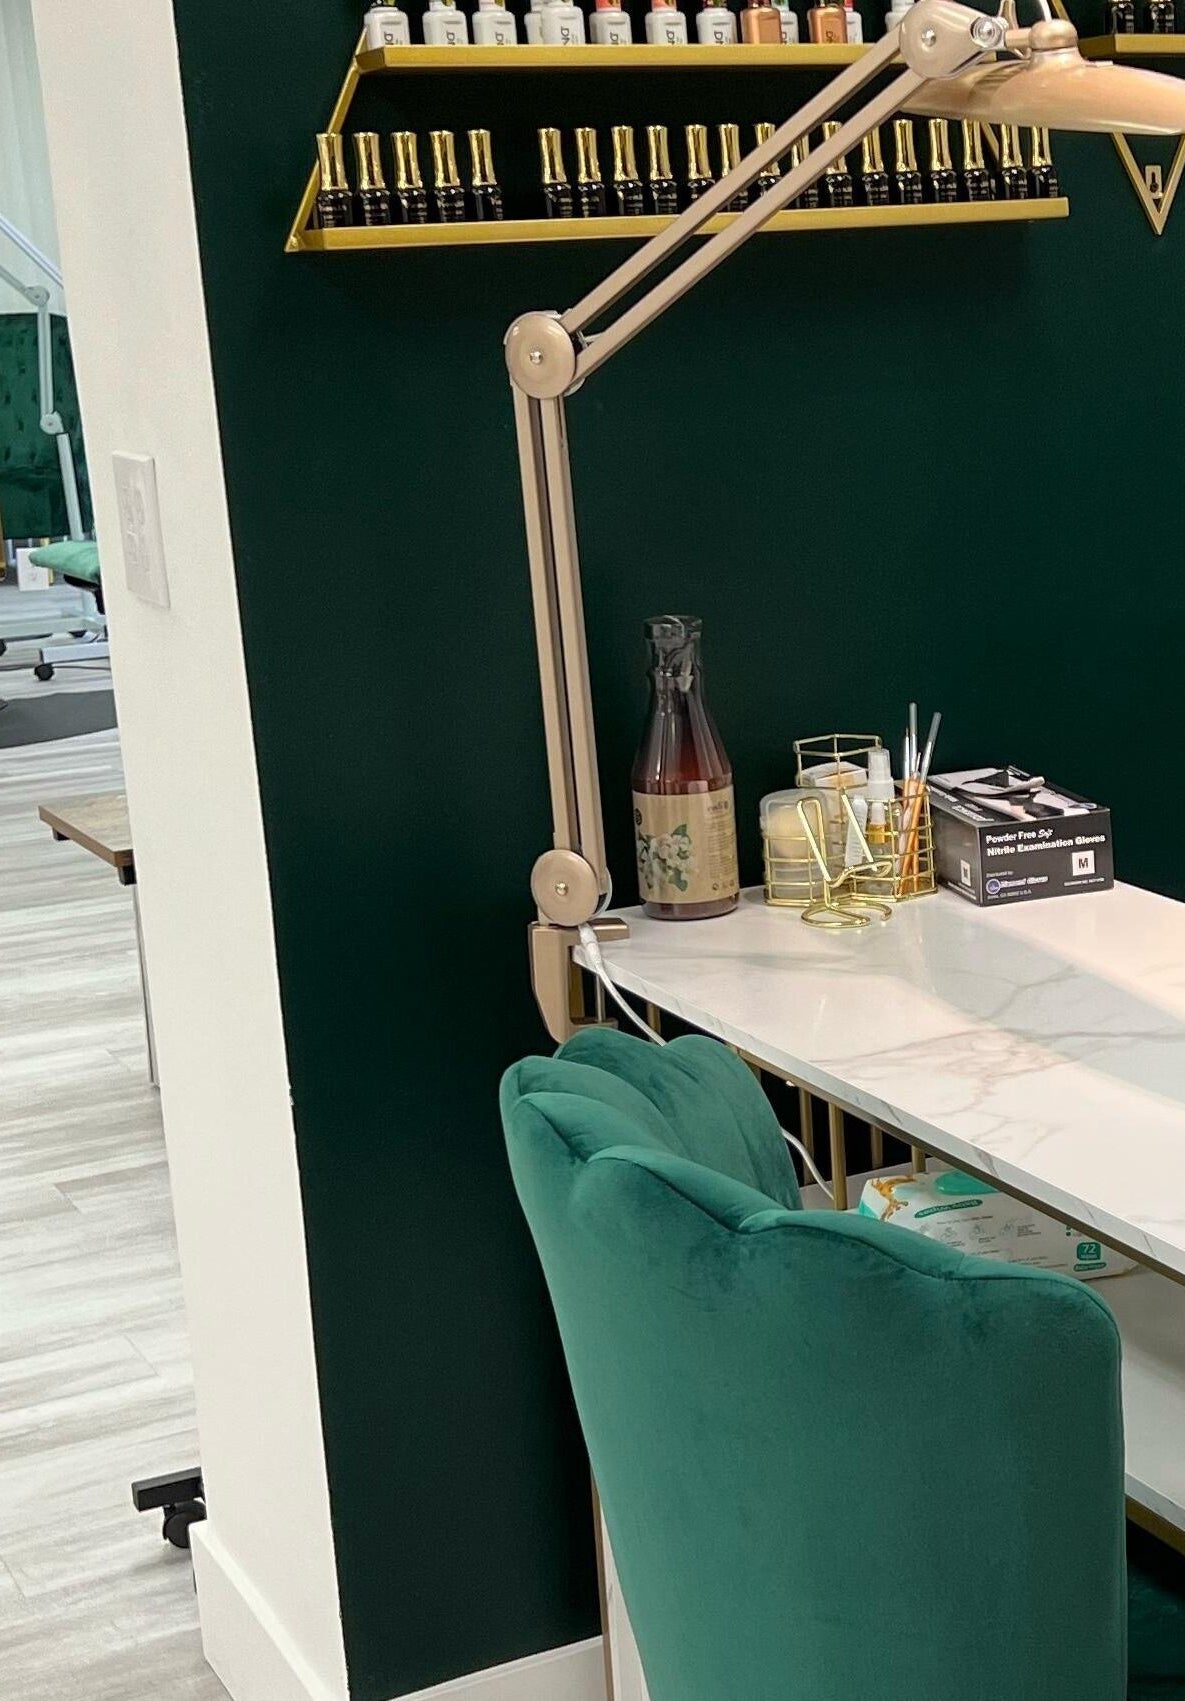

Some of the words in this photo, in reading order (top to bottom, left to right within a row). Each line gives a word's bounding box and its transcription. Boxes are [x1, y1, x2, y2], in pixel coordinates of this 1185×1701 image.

[985, 834, 1017, 844] Powder
[1018, 831, 1036, 840] Free
[986, 845, 1016, 857] Nitrile
[1017, 839, 1073, 852] Examination
[1075, 834, 1106, 845] Gloves
[1078, 857, 1089, 869] M
[1082, 1244, 1096, 1254] 72
